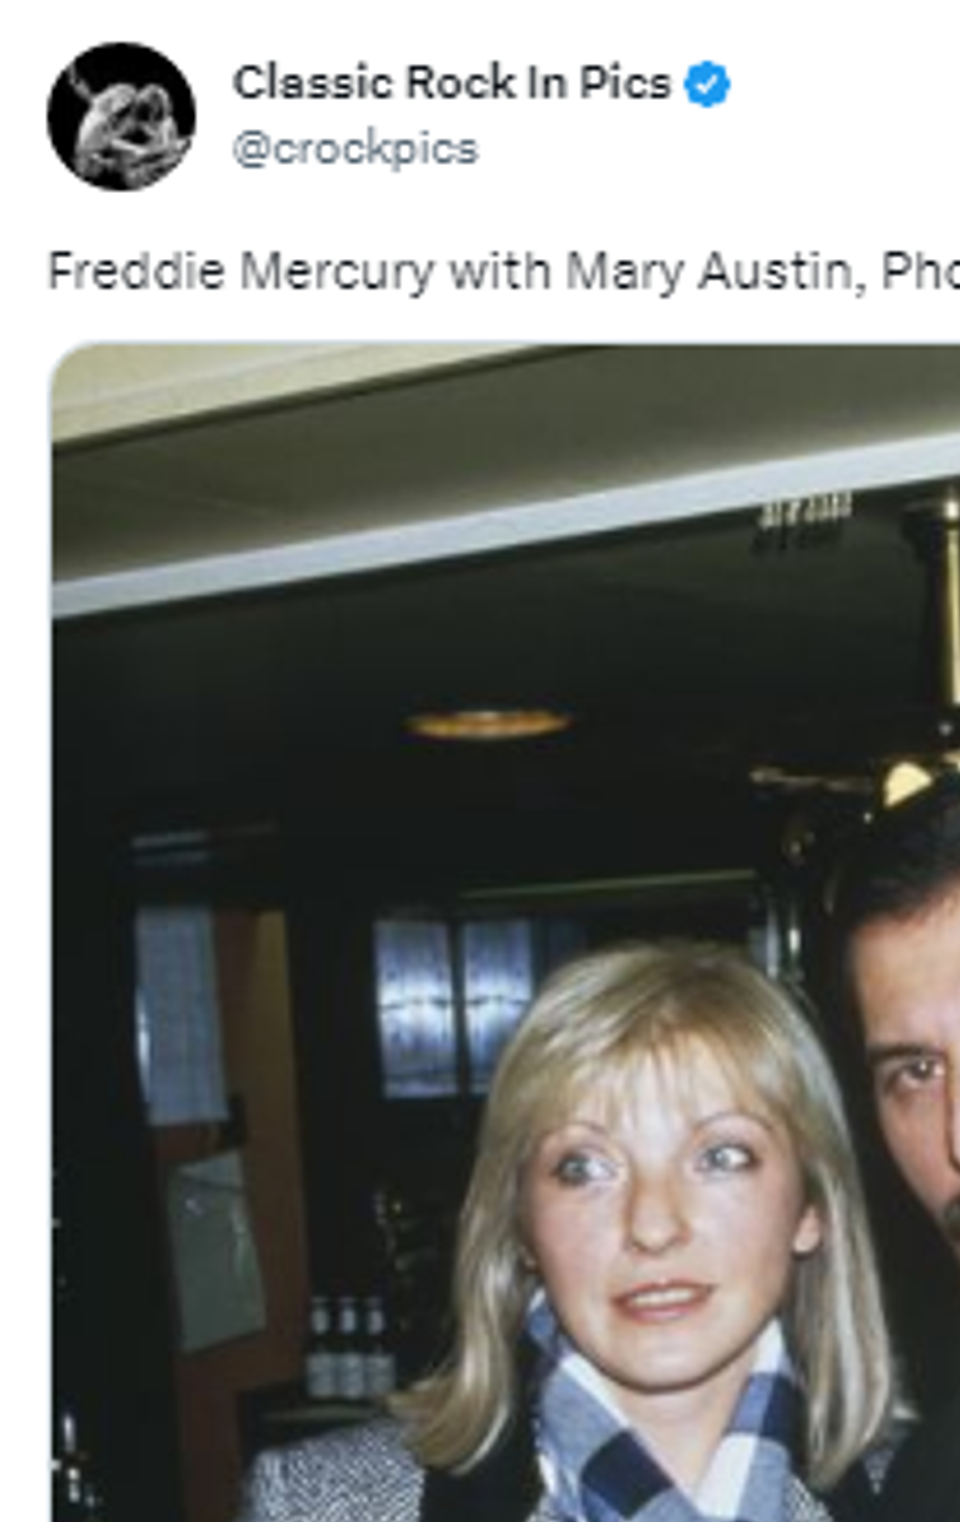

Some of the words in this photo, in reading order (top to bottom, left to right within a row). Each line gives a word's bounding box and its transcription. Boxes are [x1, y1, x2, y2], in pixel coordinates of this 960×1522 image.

[233, 60, 393, 99] Classic
[407, 60, 517, 99] Rock
[529, 64, 567, 99] In
[581, 61, 671, 99] Pics
[233, 126, 479, 172] @crockpics
[50, 250, 225, 290] Freddie
[242, 251, 435, 299] Mercury
[449, 251, 550, 290] with
[568, 251, 685, 299] Mary
[697, 251, 866, 298] Austin,
